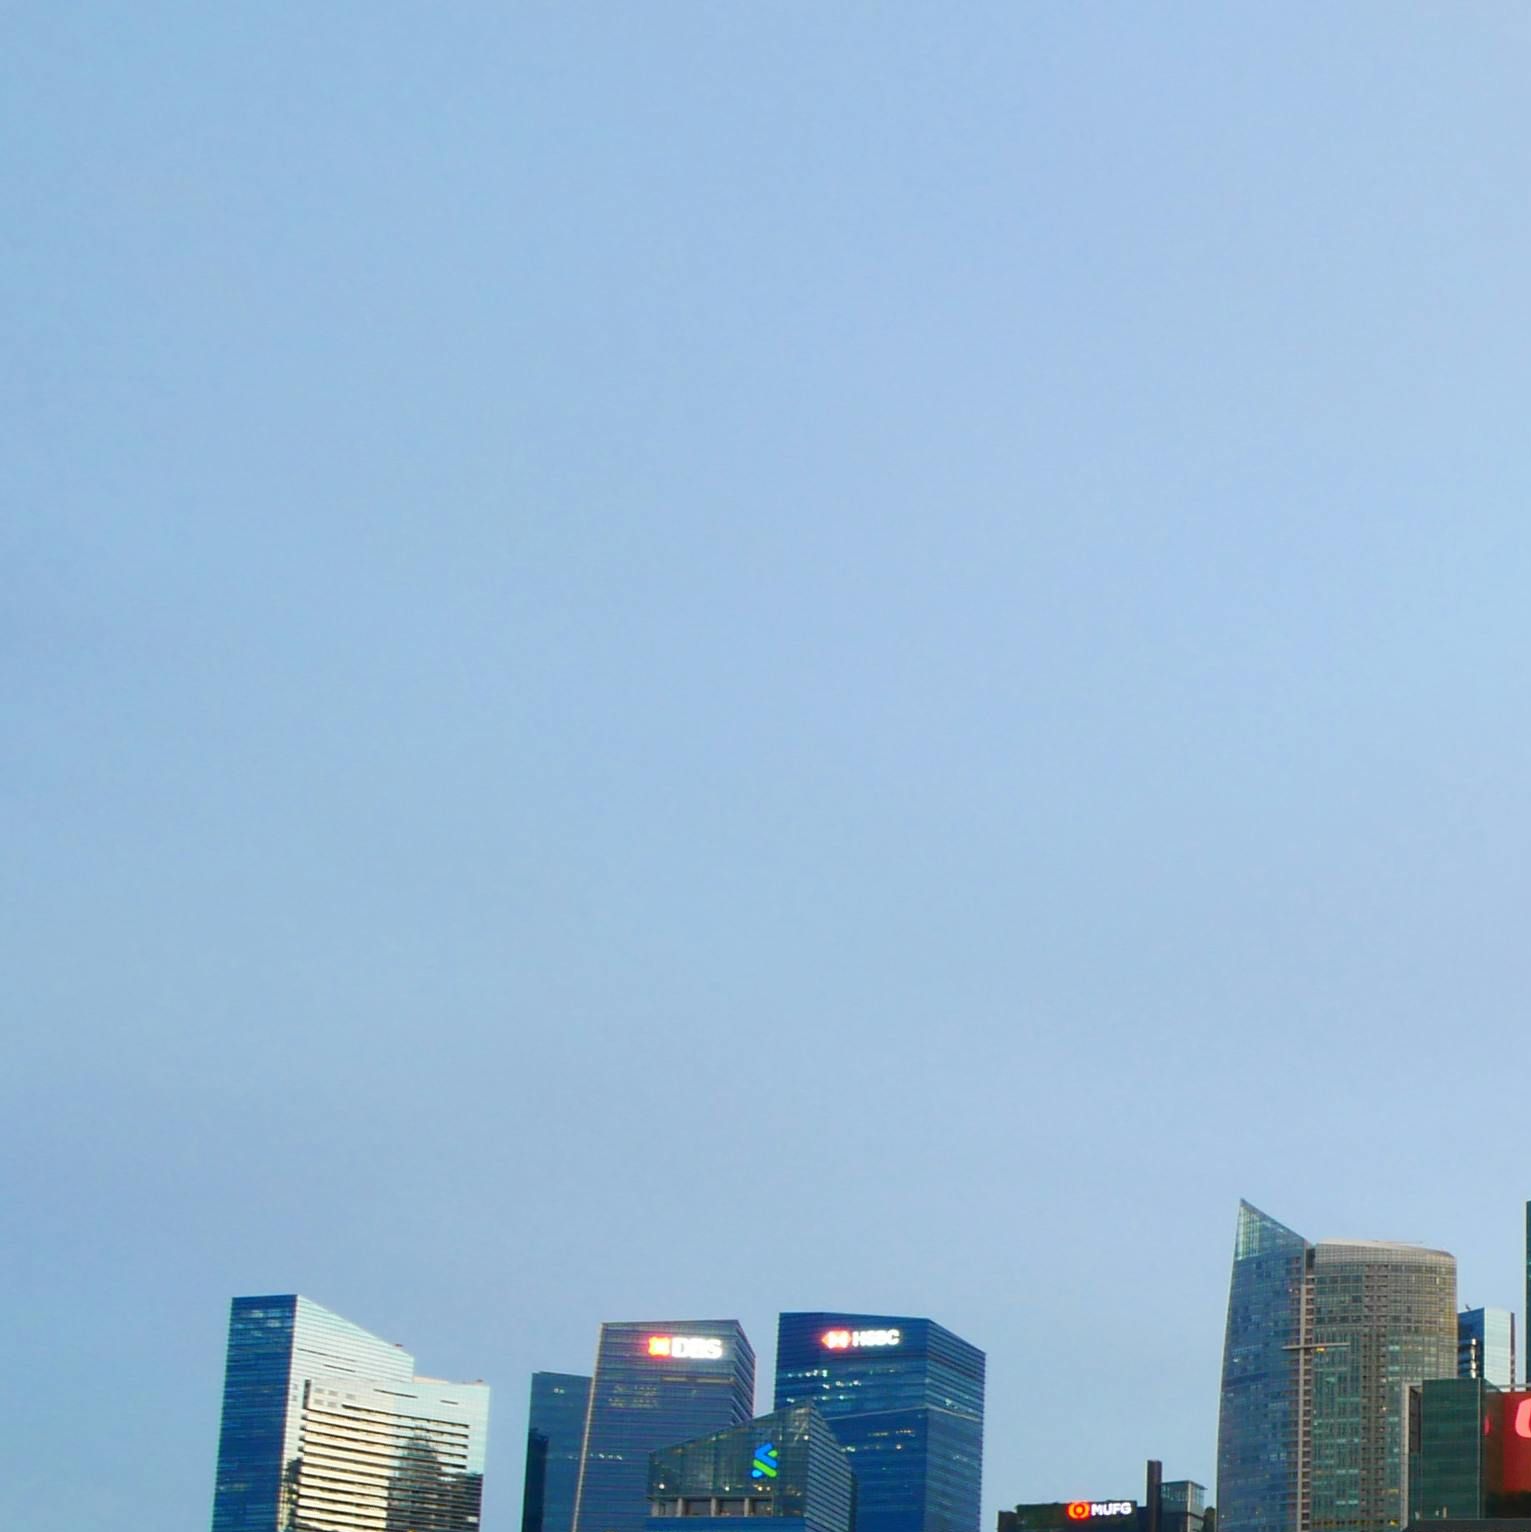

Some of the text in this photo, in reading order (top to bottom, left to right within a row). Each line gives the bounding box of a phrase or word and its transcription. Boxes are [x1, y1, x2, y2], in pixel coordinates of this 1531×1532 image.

[852, 1329, 900, 1347] HSBC
[671, 1337, 722, 1359] DBS
[1091, 1502, 1132, 1516] MUFG
